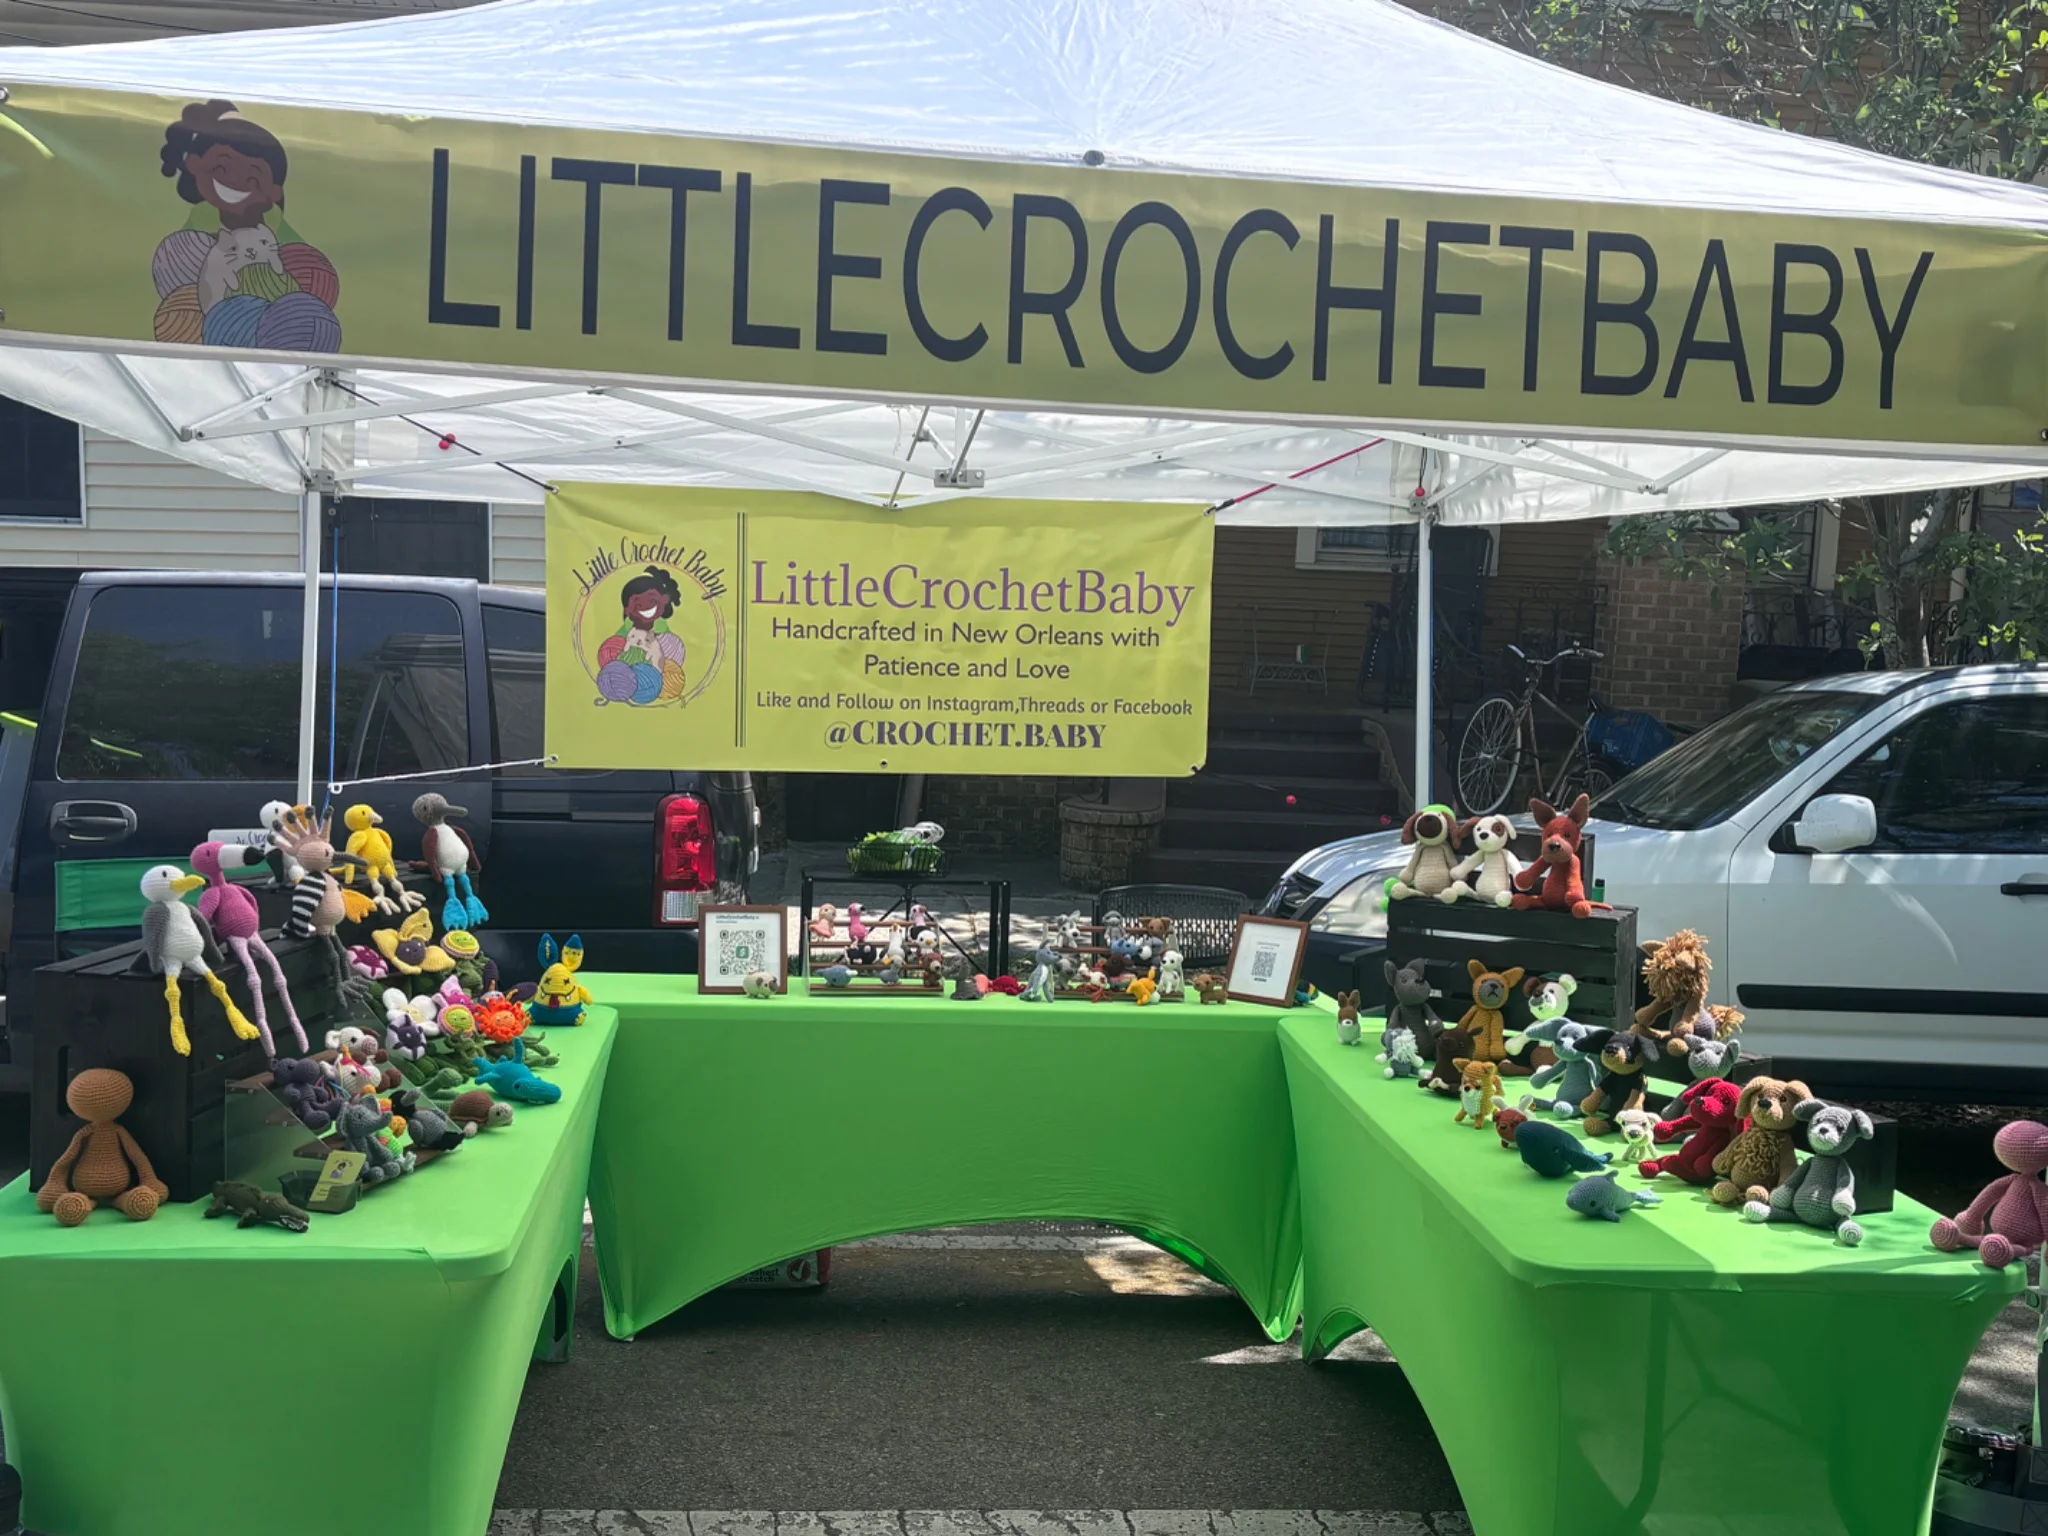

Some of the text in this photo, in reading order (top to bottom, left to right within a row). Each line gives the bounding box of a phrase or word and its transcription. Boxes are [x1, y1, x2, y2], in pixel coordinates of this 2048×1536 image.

[429, 148, 1934, 411] LITTLECROCHETBABY
[570, 535, 728, 600] Little Crochet Baby
[751, 559, 1196, 627] LittleCrochetBaby
[772, 616, 1160, 648] Handcrafted in New Orleans with
[864, 654, 1071, 680] Patience and Love
[756, 690, 792, 708] Like
[796, 691, 831, 709] and
[836, 692, 894, 711] Follow
[899, 697, 921, 711] on
[1090, 701, 1109, 714] or
[1113, 698, 1193, 716] Facebook
[824, 719, 1107, 750] @CROCHET.BABY
